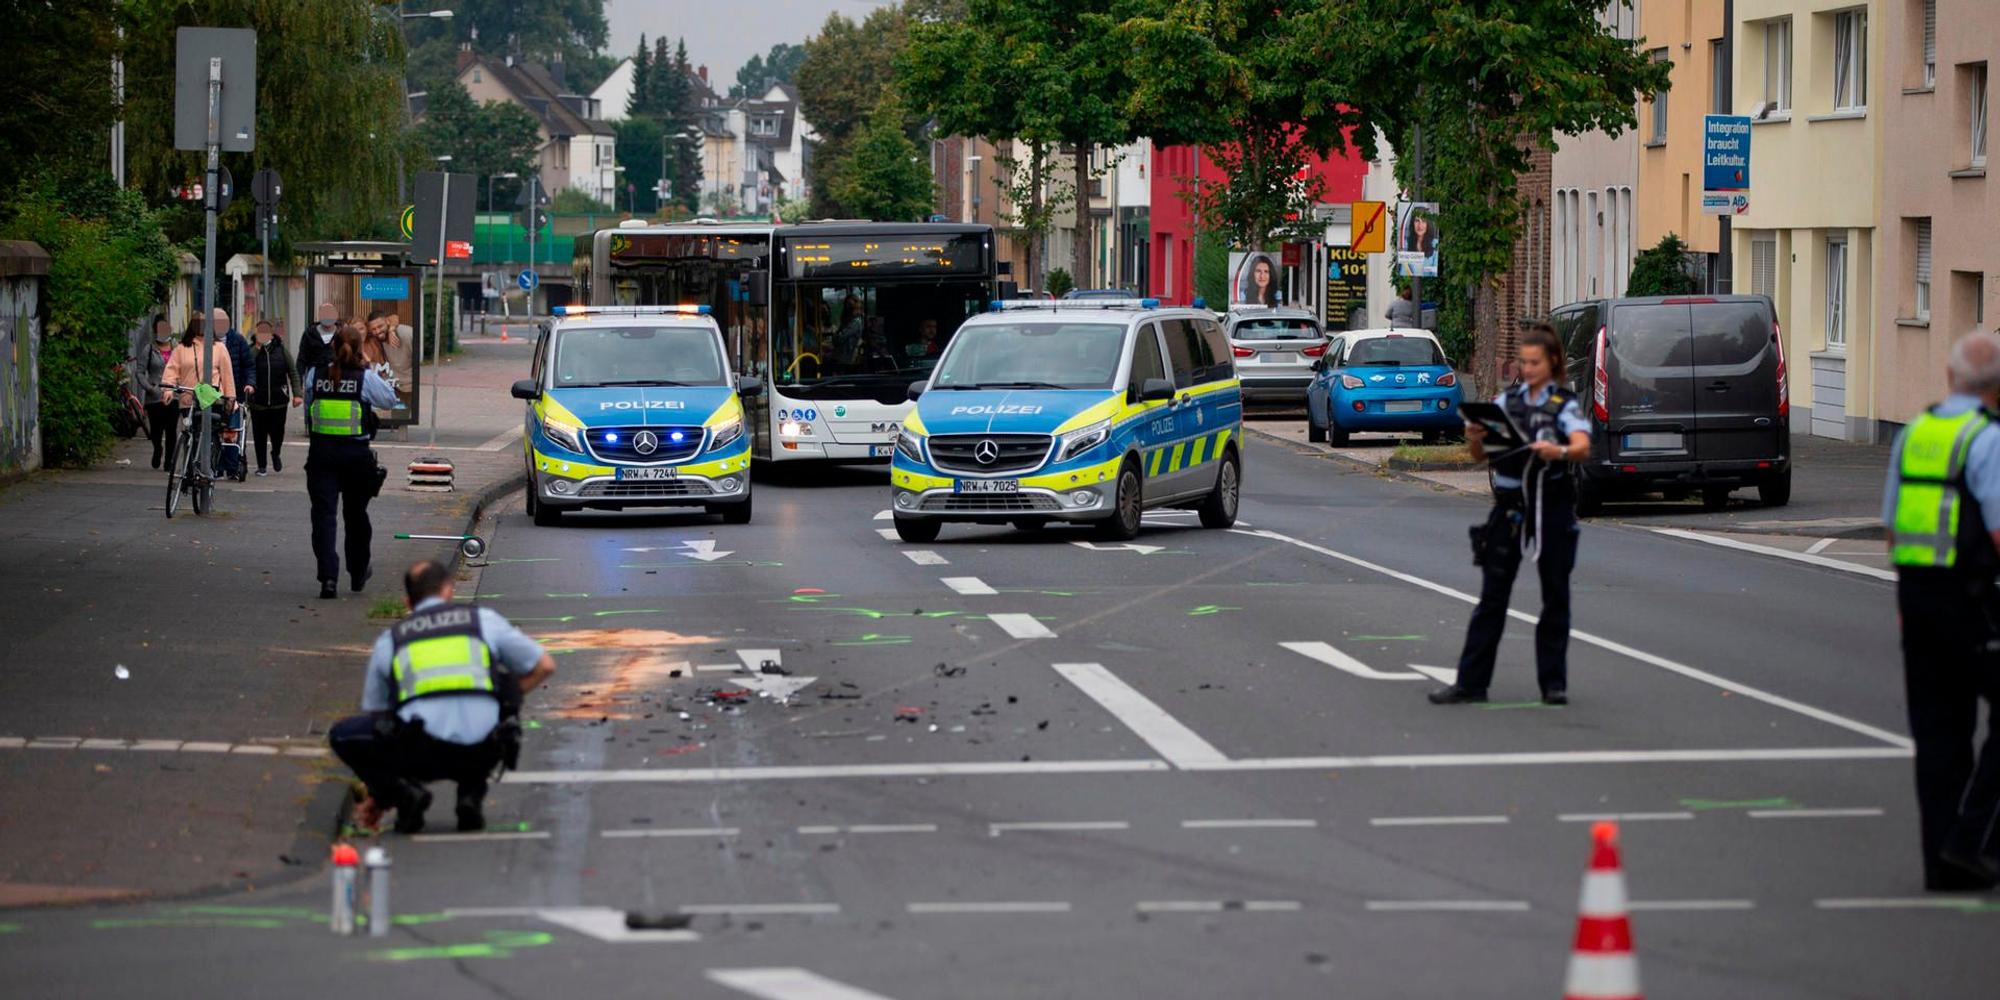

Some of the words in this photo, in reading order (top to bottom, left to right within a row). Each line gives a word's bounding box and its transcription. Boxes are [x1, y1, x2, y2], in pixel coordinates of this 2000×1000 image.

[1708, 121, 1749, 136] Integration
[1707, 137, 1739, 150] braucht
[1707, 154, 1746, 166] Leitkultur.
[1733, 195, 1746, 206] AfD
[1331, 248, 1367, 260] KIOS
[1341, 264, 1367, 275] 101
[315, 379, 358, 393] POLZEI
[600, 400, 685, 410] POLIZEI
[951, 406, 1043, 415] POLIZEI
[871, 423, 899, 432] MA
[1151, 417, 1175, 436] POLIZEI
[621, 469, 639, 479] NRW
[960, 481, 978, 491] NRW
[400, 608, 472, 636] POLIZEI
